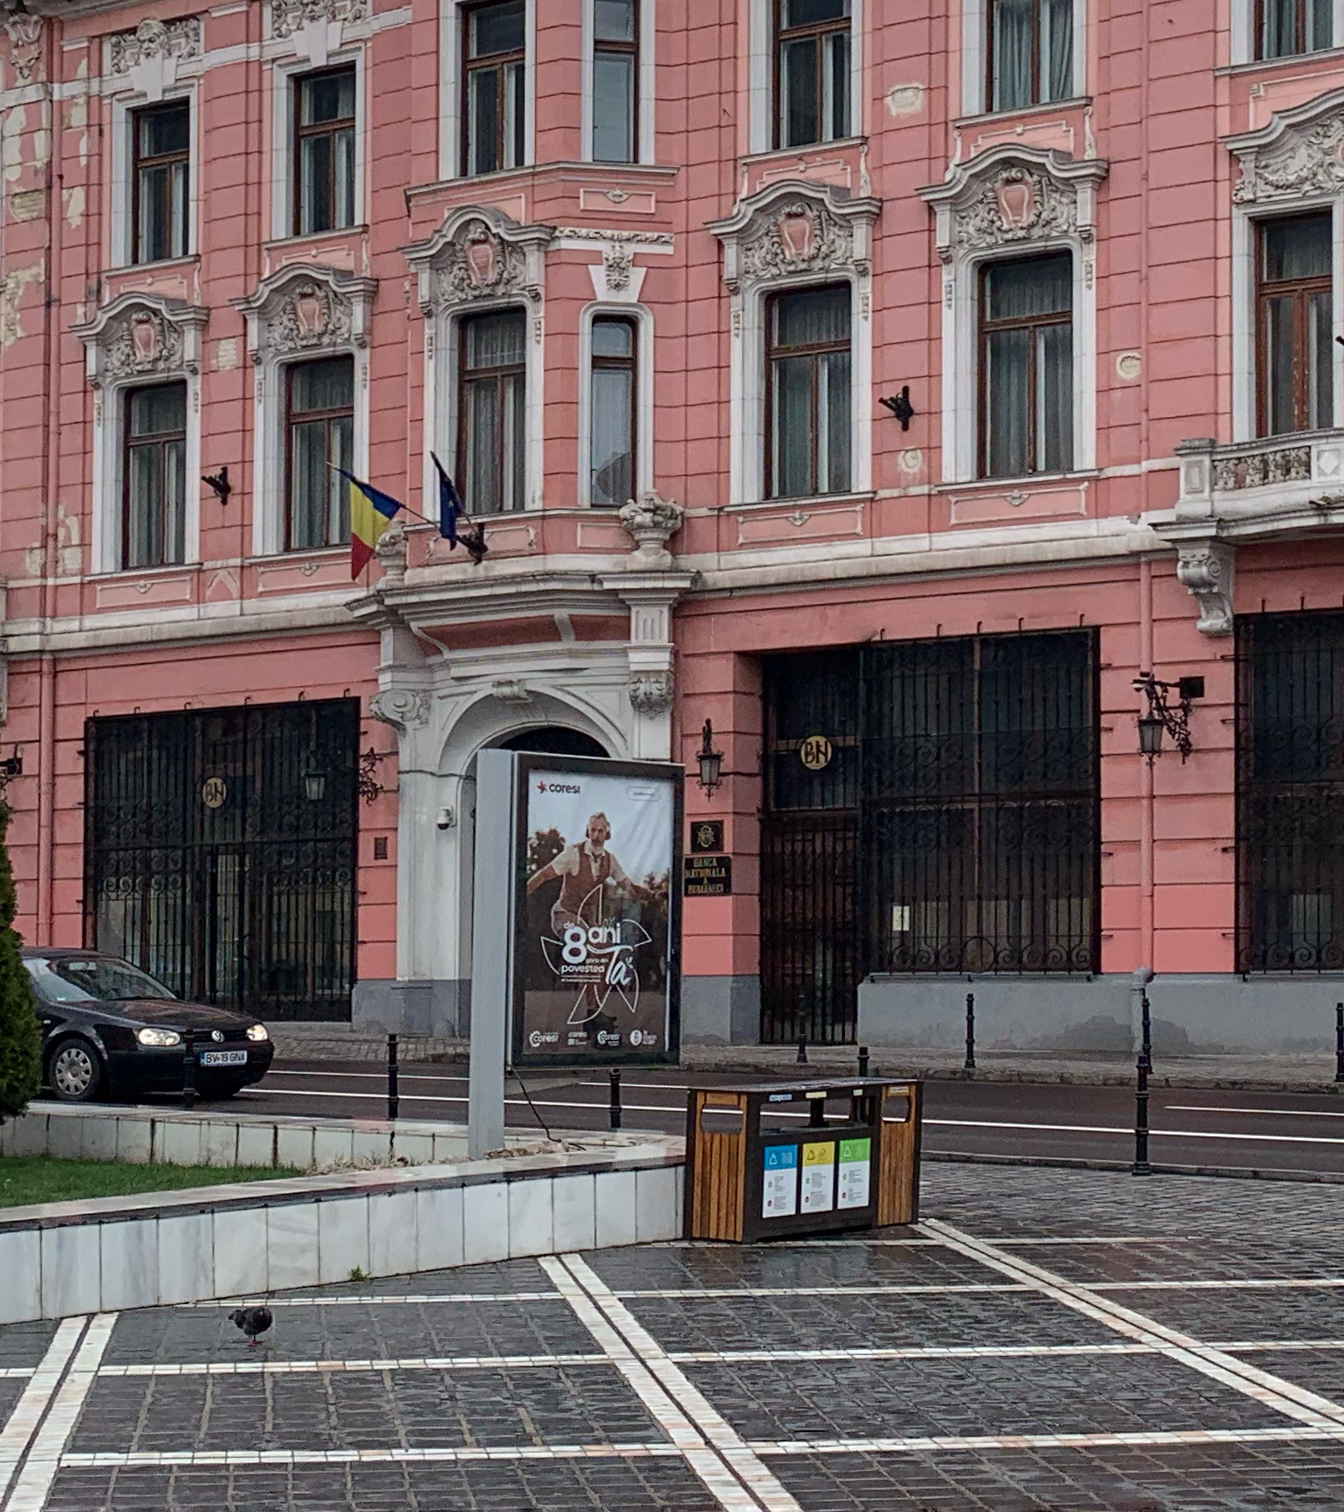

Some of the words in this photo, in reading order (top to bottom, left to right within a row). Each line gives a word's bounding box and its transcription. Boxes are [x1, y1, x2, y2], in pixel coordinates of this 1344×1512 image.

[562, 926, 587, 964] 8
[588, 922, 621, 944] ani
[561, 964, 605, 974] povestea
